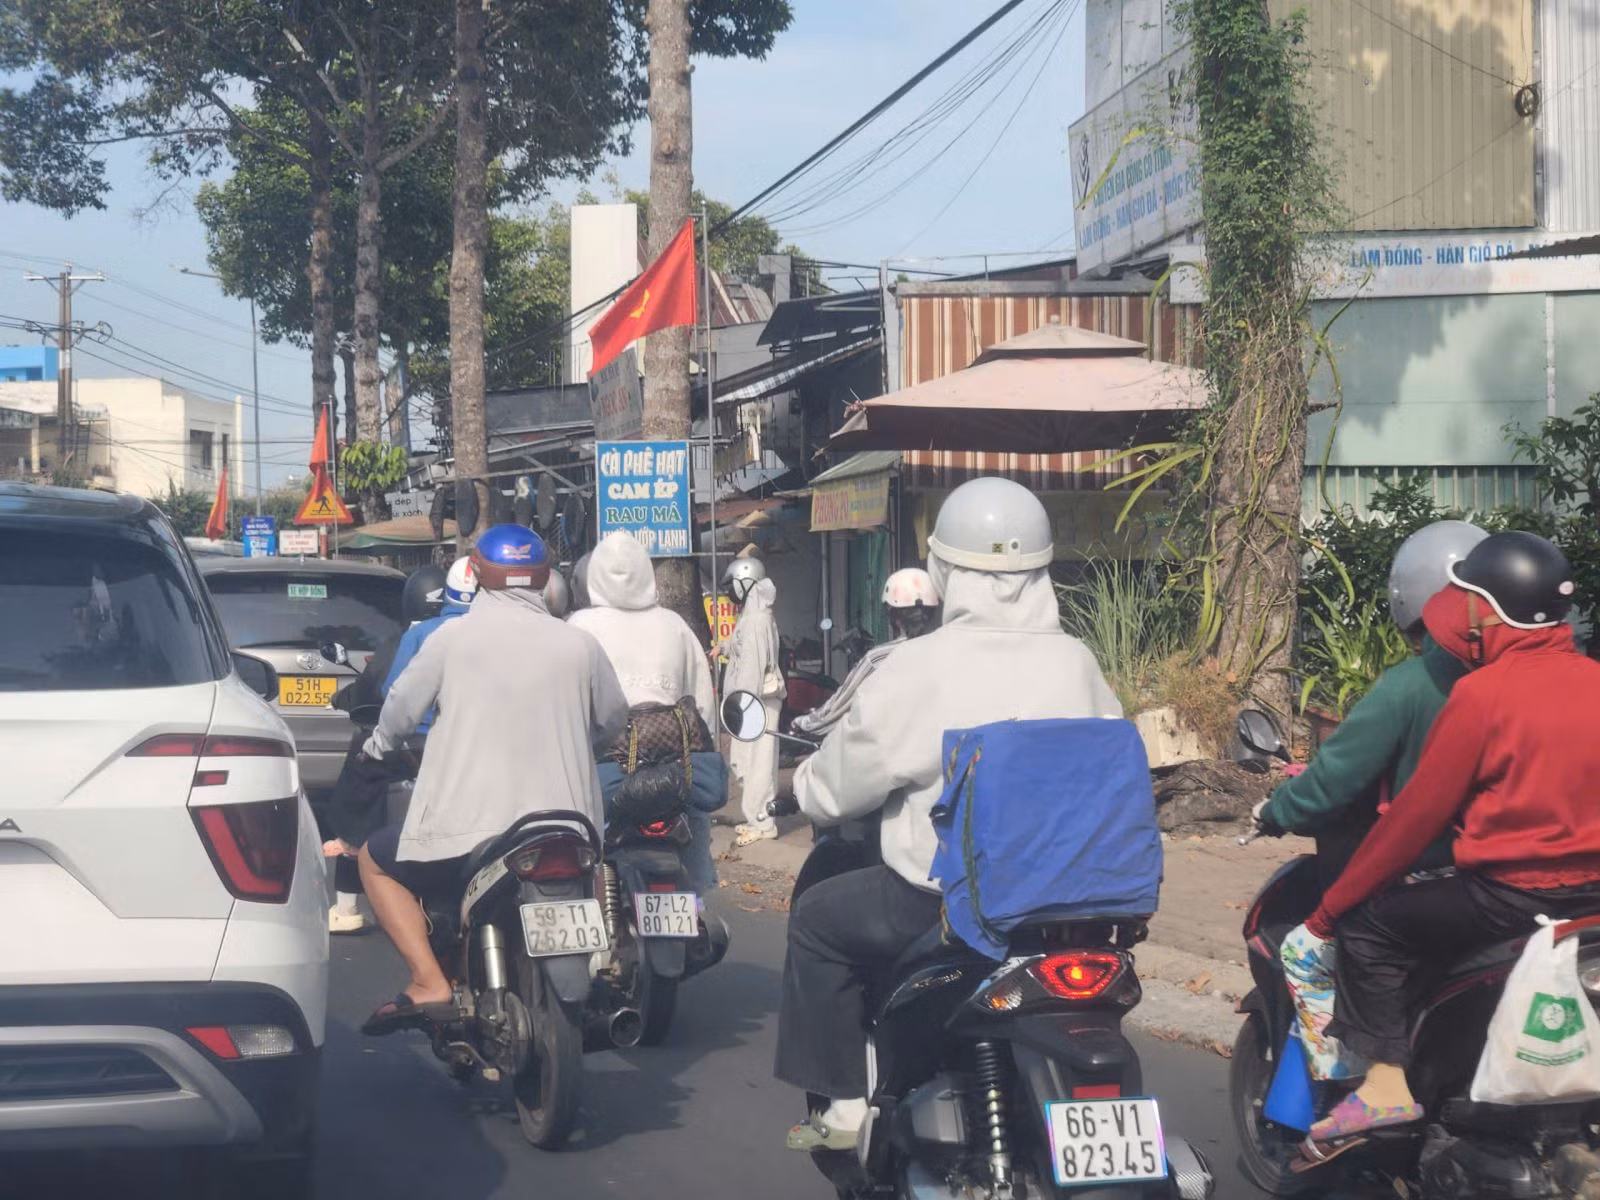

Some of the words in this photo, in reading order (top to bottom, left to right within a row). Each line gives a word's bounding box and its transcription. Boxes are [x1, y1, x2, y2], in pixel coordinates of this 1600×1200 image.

[623, 446, 653, 476] PHÊ
[656, 449, 686, 480] HẠT
[608, 482, 650, 500] CAM
[606, 506, 647, 524] RAU
[651, 501, 682, 523] MÁ
[296, 679, 321, 691] 51H
[286, 692, 331, 704] 022.55
[645, 896, 688, 913] 67-L2
[534, 904, 588, 926] 59-T1
[643, 915, 693, 933] 801.21
[1066, 1104, 1141, 1138] 66-V1
[1063, 1141, 1155, 1178] 823.45
